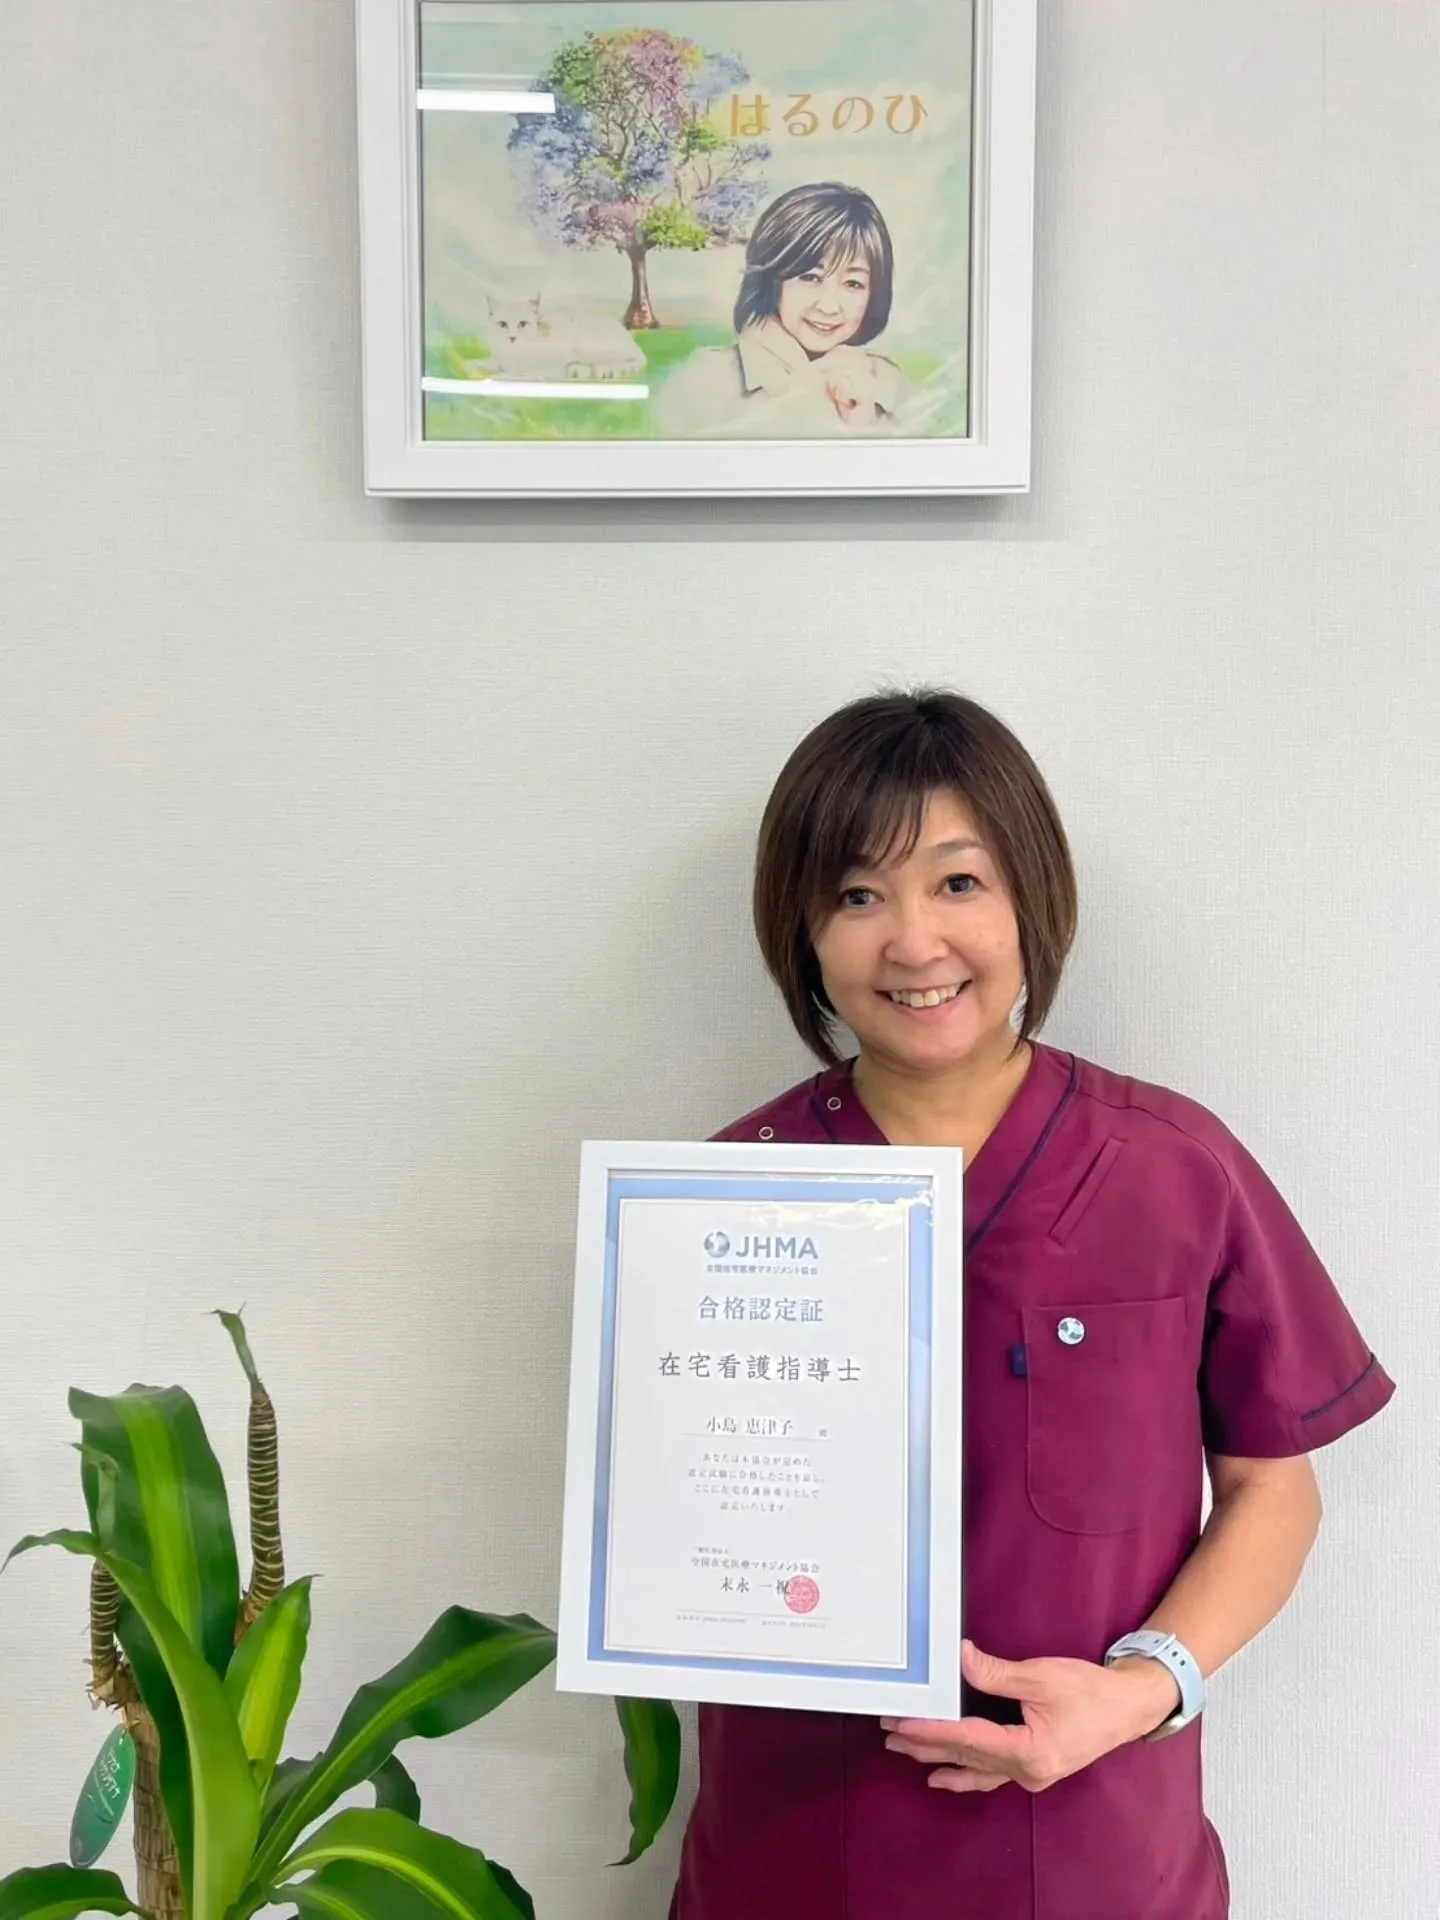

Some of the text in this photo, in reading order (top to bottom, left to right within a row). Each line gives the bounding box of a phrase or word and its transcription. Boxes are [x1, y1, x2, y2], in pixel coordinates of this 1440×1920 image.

[729, 94, 929, 137] はるのひ
[735, 1236, 818, 1260] JHMA
[698, 1295, 824, 1322] 合格認定証
[658, 1352, 862, 1383] 在宅看護指導士
